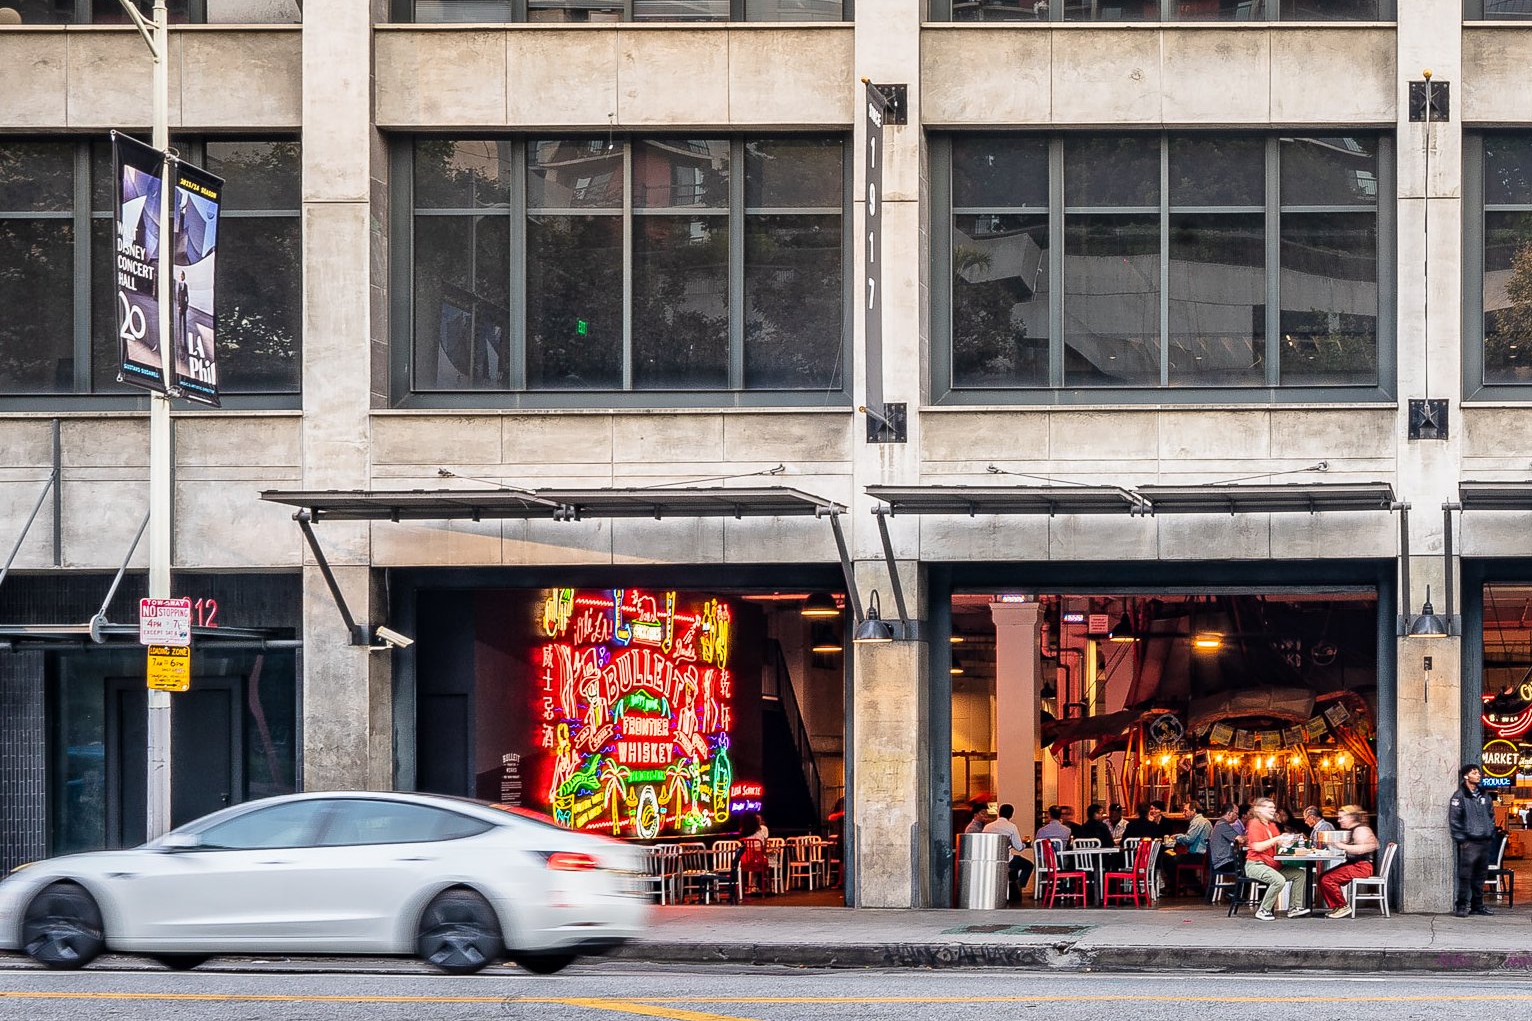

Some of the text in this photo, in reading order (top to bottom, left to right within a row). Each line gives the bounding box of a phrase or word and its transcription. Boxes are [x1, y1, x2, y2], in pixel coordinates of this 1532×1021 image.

[201, 187, 217, 198] SEASON
[868, 137, 877, 309] 1917
[117, 238, 146, 260] DSNEY
[118, 255, 155, 280] CONCERT
[118, 272, 137, 291] HALL
[119, 291, 146, 341] 20
[188, 332, 206, 358] LA
[189, 357, 217, 386] Phil
[143, 606, 188, 617] NO STOPPING
[602, 648, 684, 708] BULLEIT
[542, 644, 554, 748] 威士忌酒
[623, 716, 669, 736] FRONTIER
[618, 742, 673, 763] WHISKEY
[1482, 752, 1519, 765] MARKET
